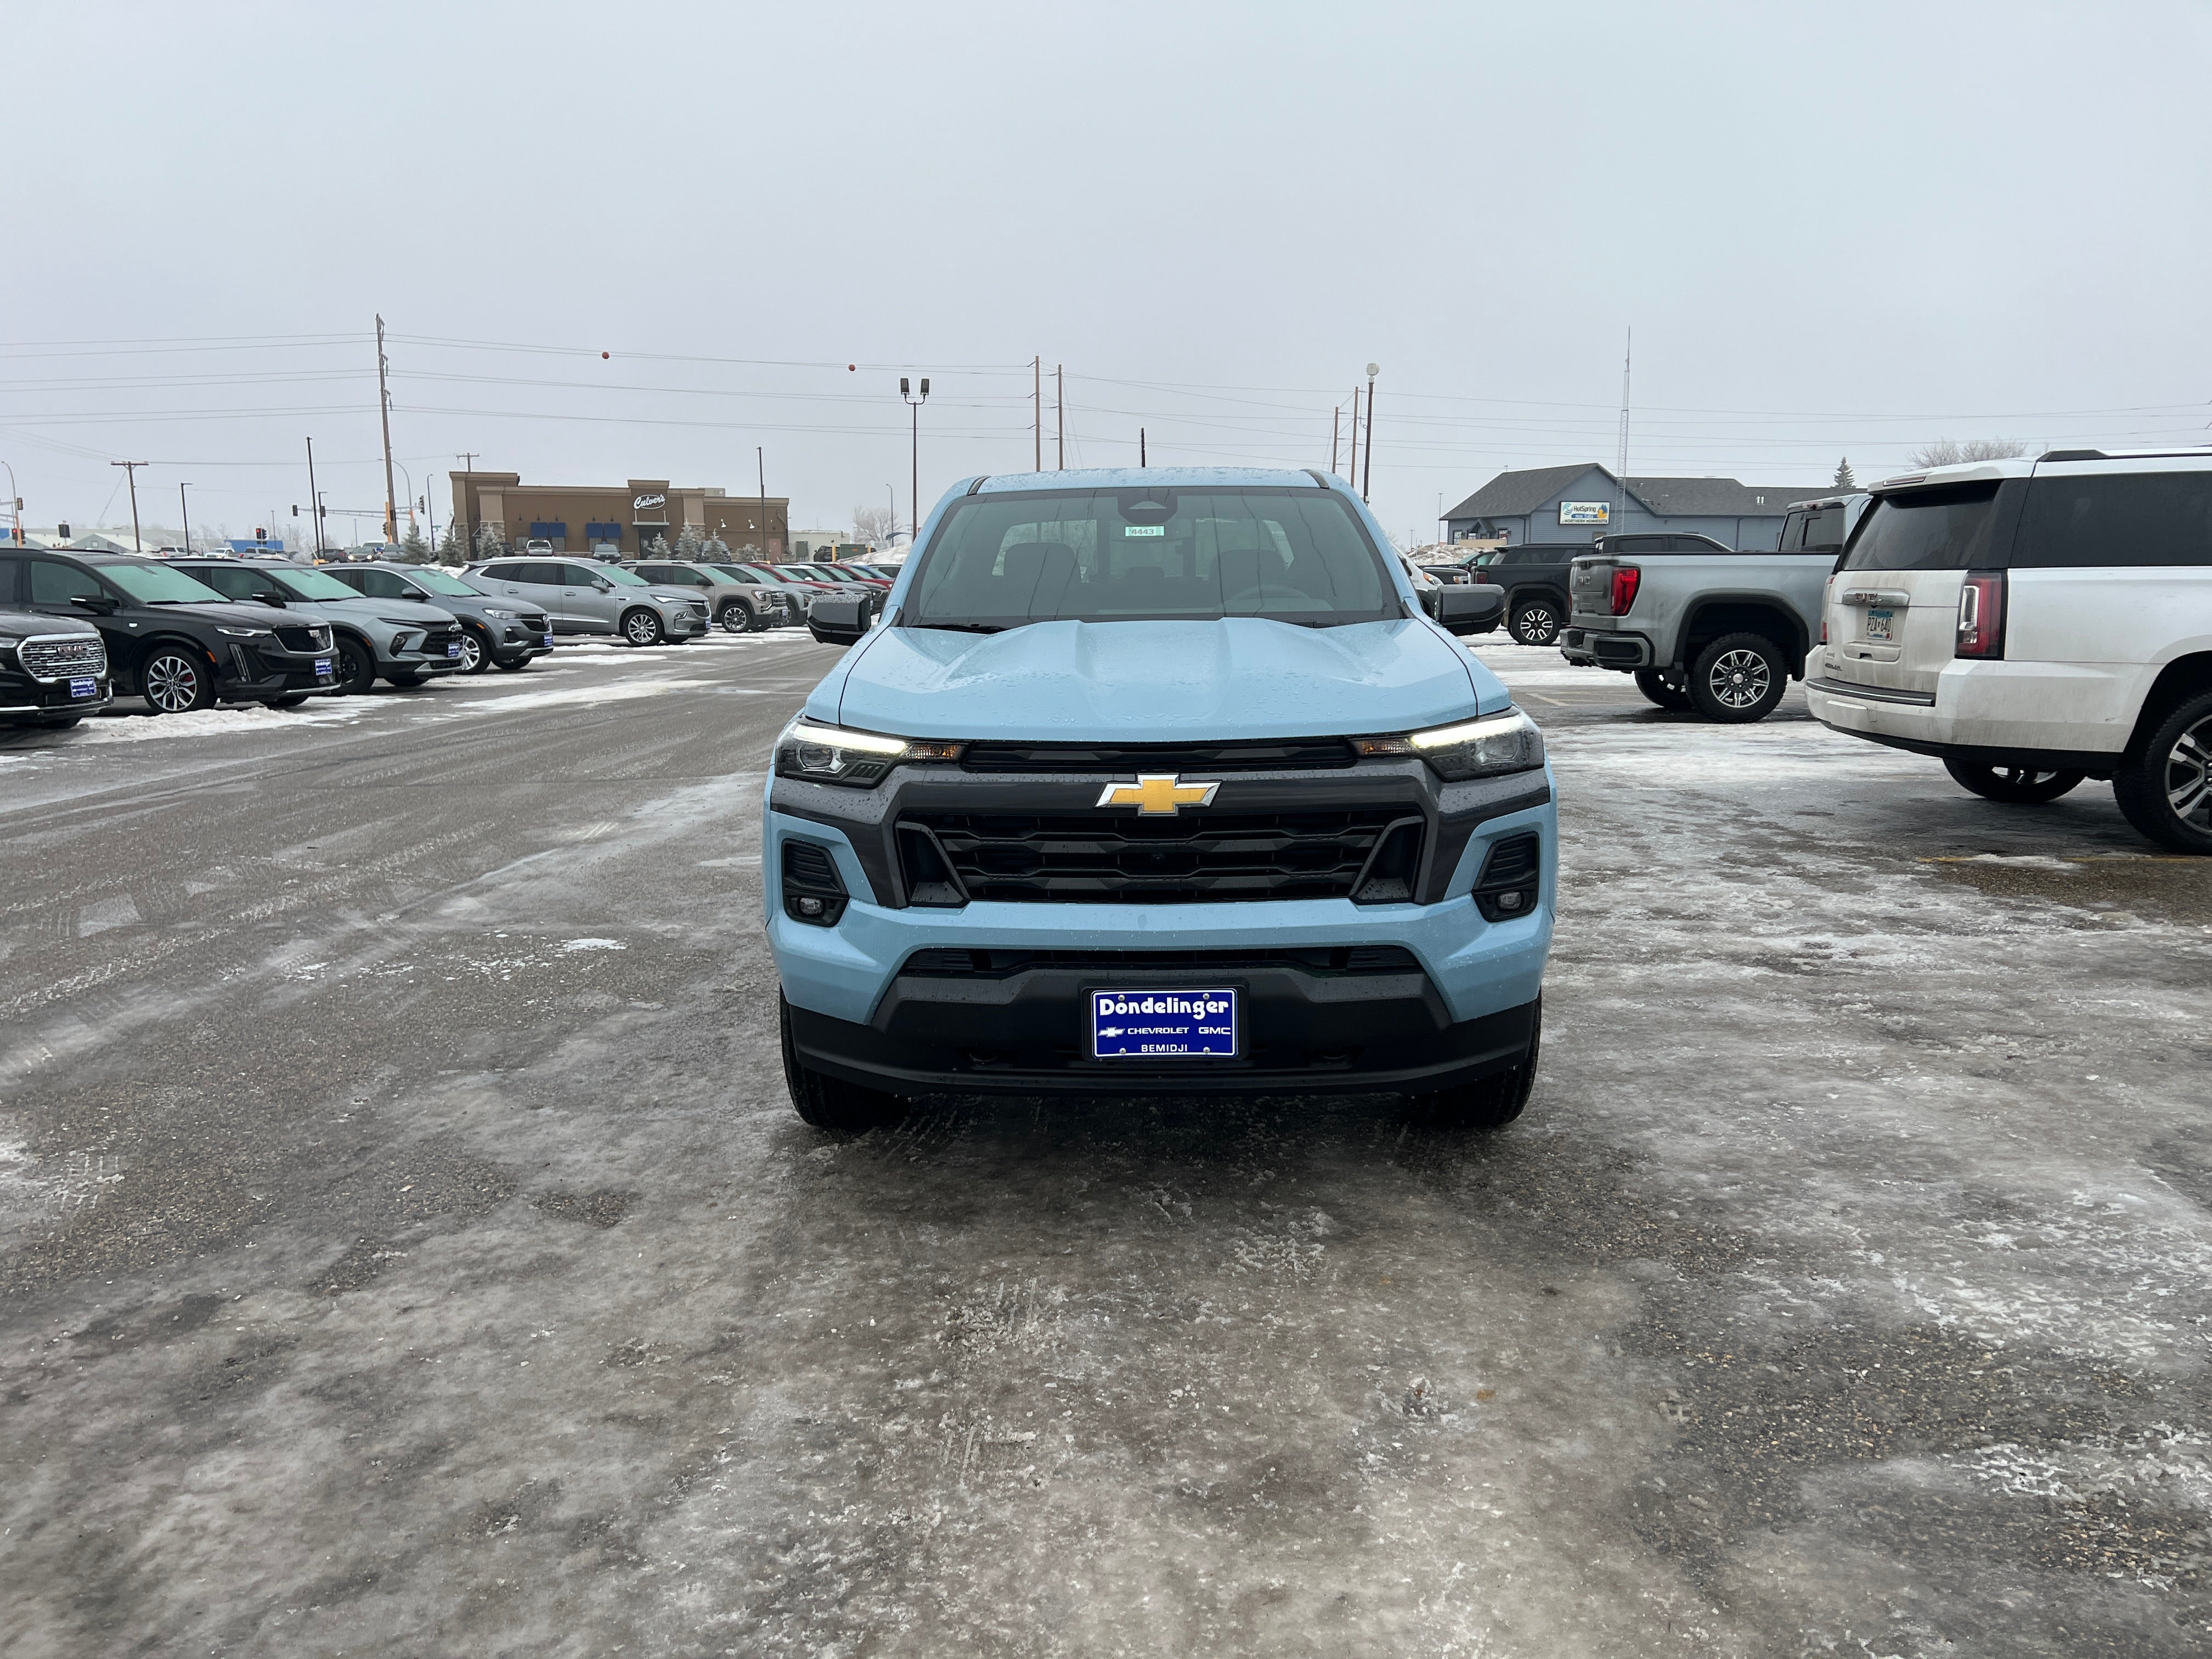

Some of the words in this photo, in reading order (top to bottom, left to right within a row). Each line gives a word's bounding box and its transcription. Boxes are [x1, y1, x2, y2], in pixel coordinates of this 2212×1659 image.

[634, 494, 665, 509] Culver's
[1099, 997, 1229, 1020] Dondelinger
[1198, 1026, 1231, 1035] GMC
[1141, 1044, 1188, 1052] BEMIDJI
